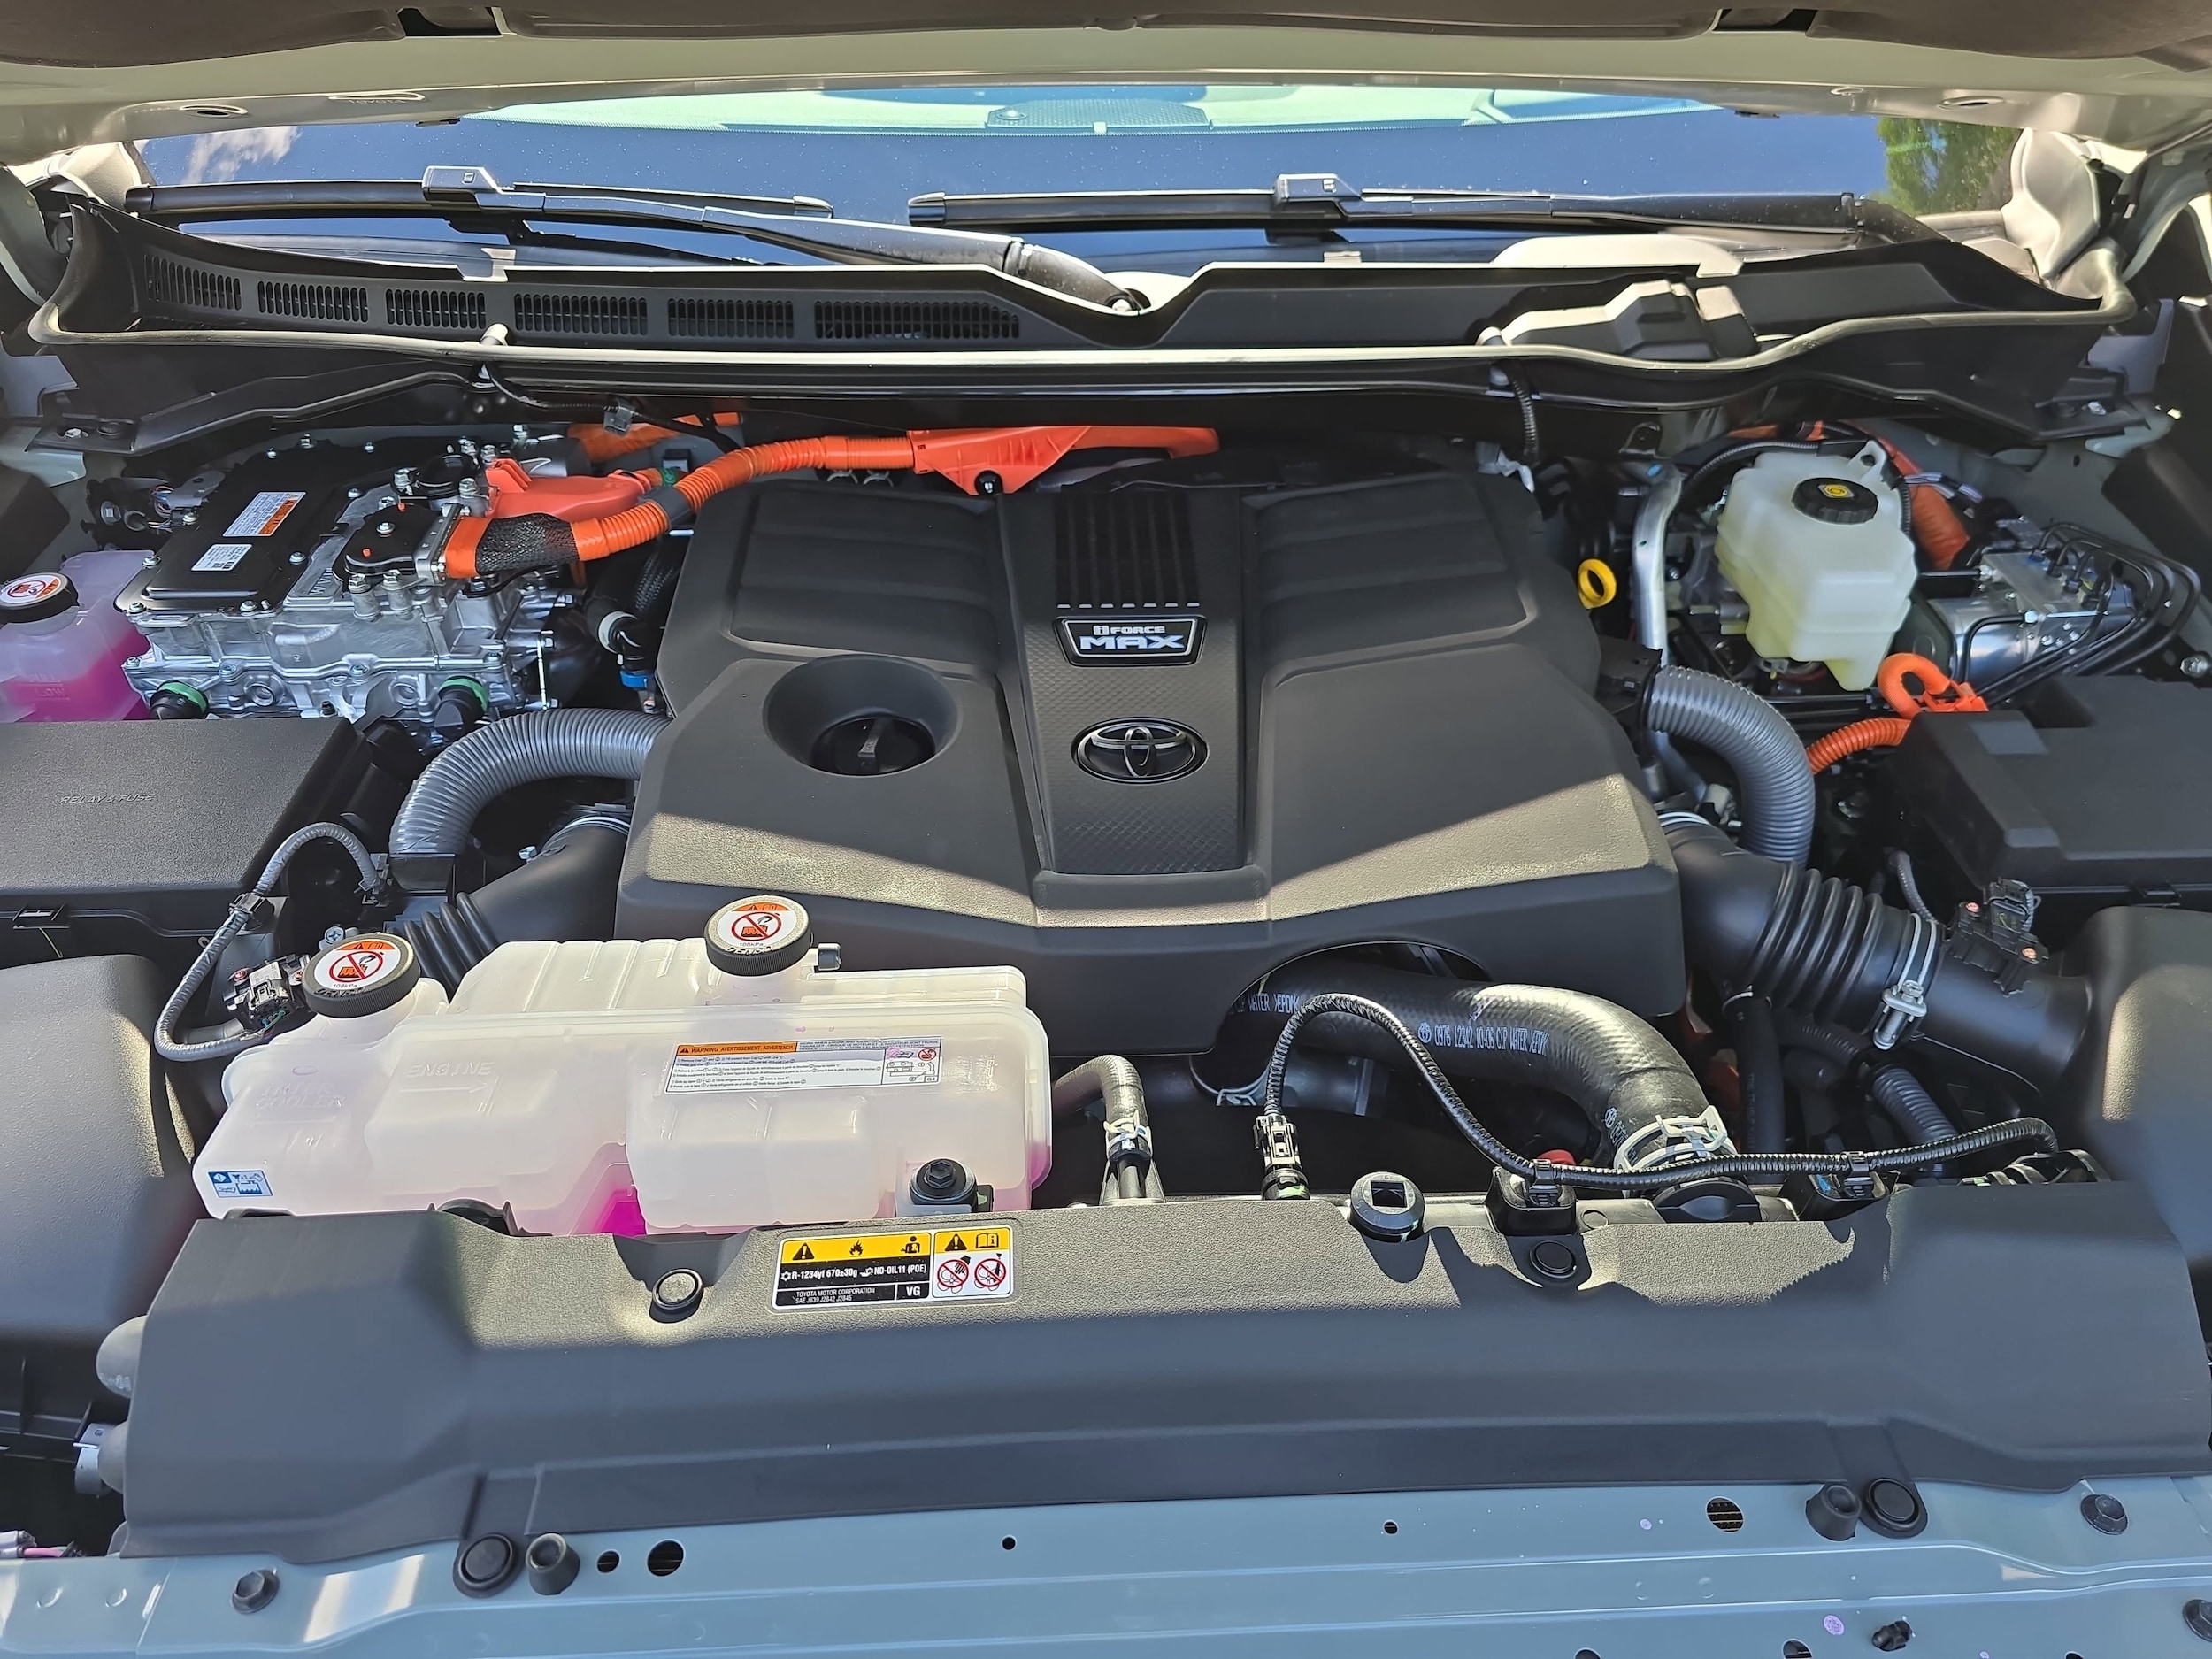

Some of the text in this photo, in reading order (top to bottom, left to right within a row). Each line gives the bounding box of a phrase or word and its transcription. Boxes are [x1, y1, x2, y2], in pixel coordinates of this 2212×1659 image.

[1110, 626, 1166, 634] FORCE
[1079, 635, 1185, 650] MAX
[119, 794, 157, 803] FUSE
[726, 945, 772, 956] DENSO
[1248, 991, 1271, 1012] WATER
[1509, 1026, 1528, 1052] WATER
[407, 1062, 495, 1077] ENGINE
[791, 1269, 825, 1280] R-1234yf
[873, 1264, 906, 1275] ND-OIL11
[907, 1263, 927, 1274] (POE)
[838, 1286, 875, 1295] CORPORATION
[906, 1286, 921, 1297] VG
